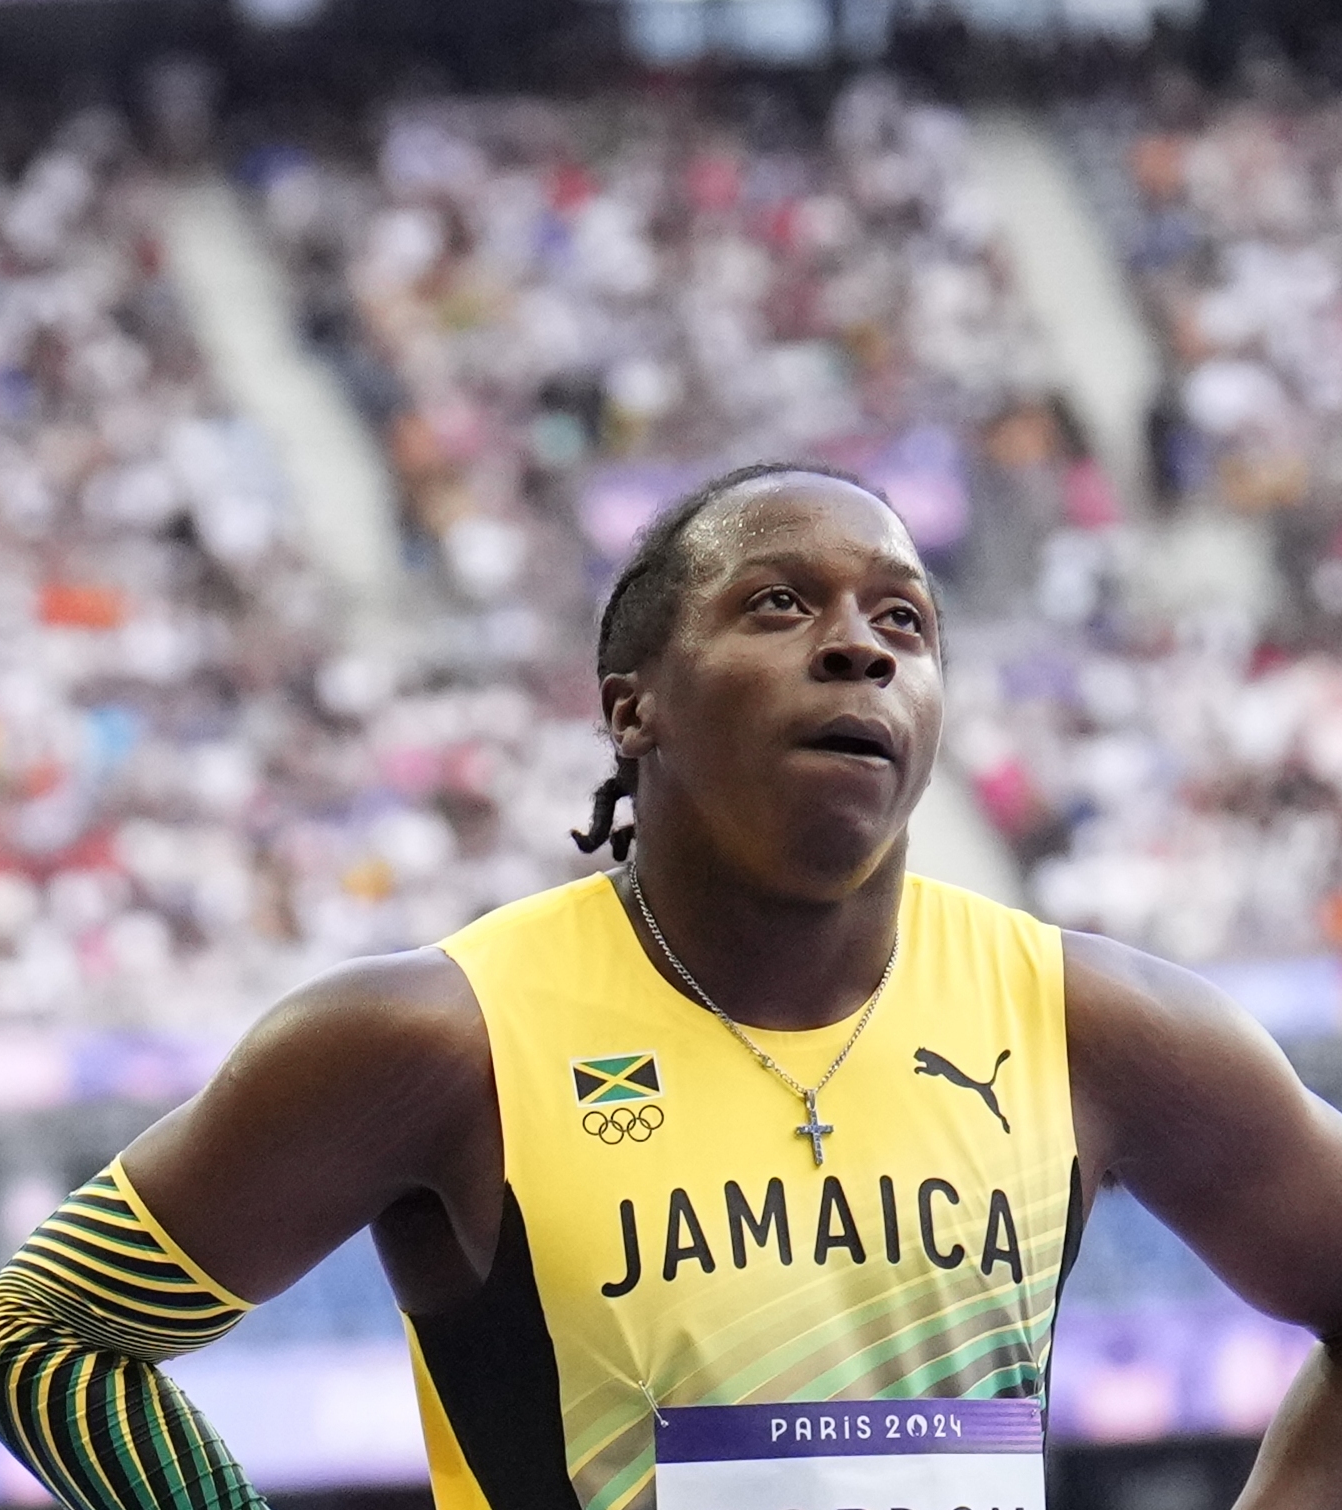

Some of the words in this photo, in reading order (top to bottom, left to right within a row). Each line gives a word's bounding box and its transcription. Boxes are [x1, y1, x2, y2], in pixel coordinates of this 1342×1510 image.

[601, 1174, 1024, 1298] JAMAICA
[770, 1415, 872, 1442] PARIS
[885, 1413, 963, 1439] 2024
